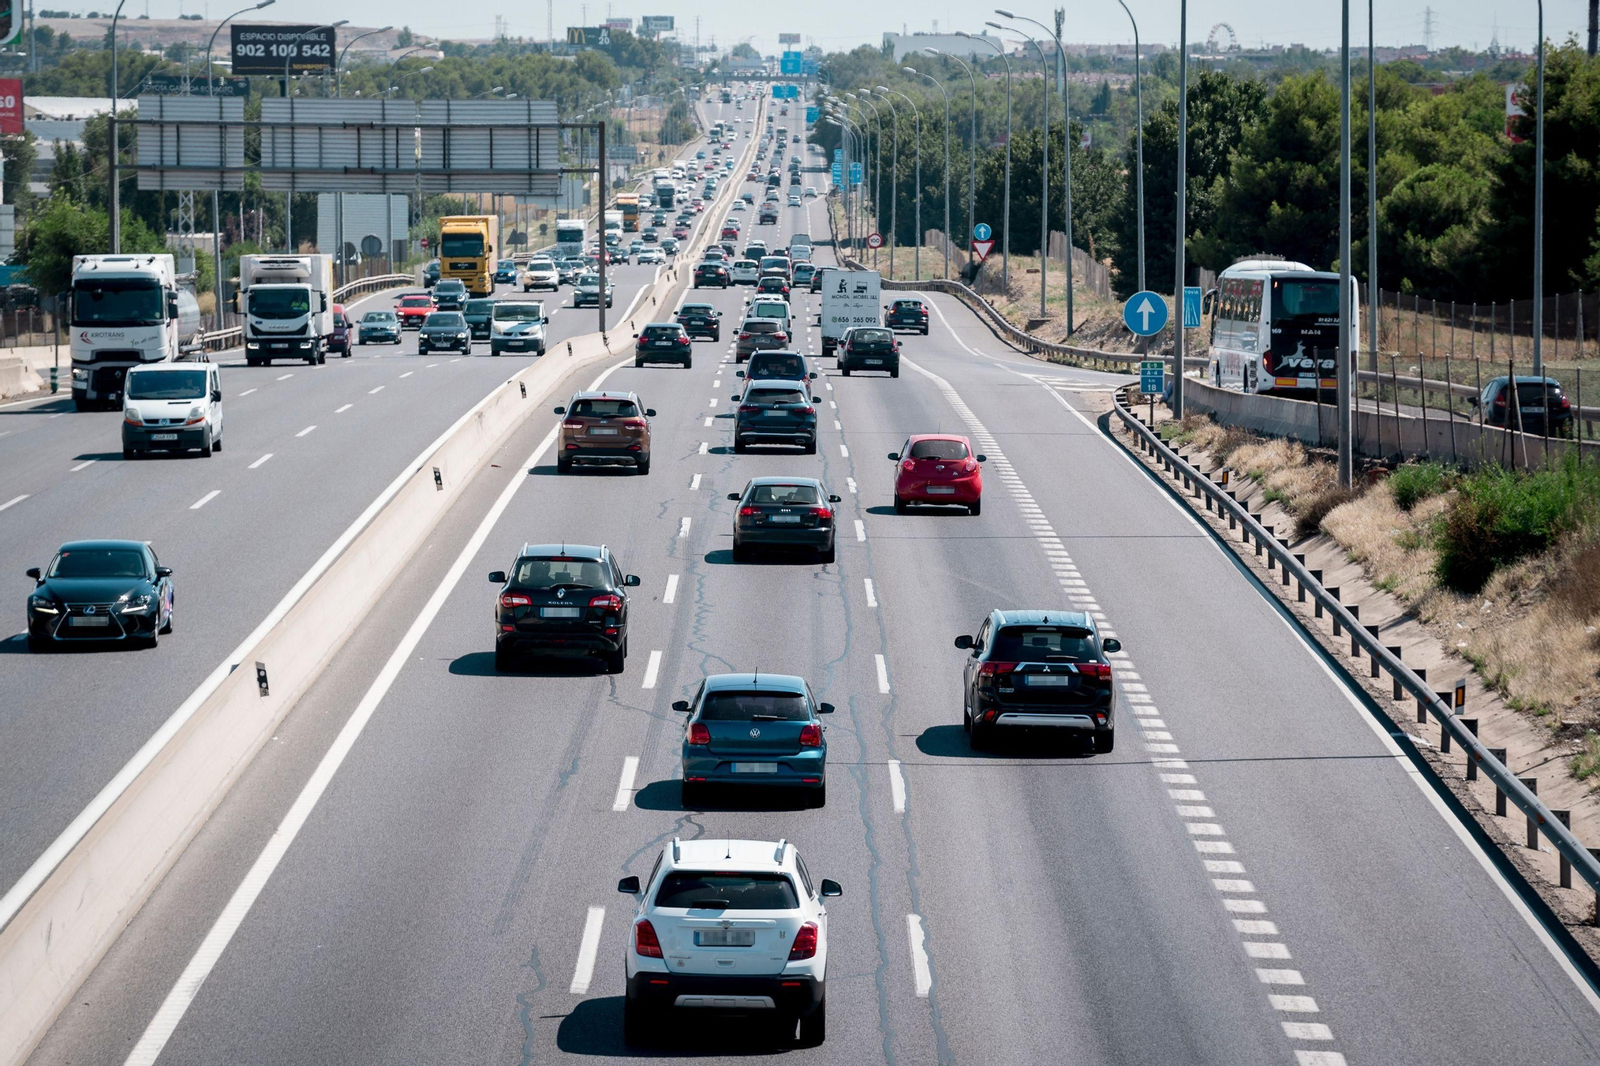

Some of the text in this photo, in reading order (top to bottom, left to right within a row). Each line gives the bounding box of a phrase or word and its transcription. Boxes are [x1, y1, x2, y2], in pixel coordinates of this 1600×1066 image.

[240, 33, 326, 41] ESPACIO DISPONIBLE
[236, 44, 331, 57] 902 100 542
[1147, 384, 1157, 392] 18
